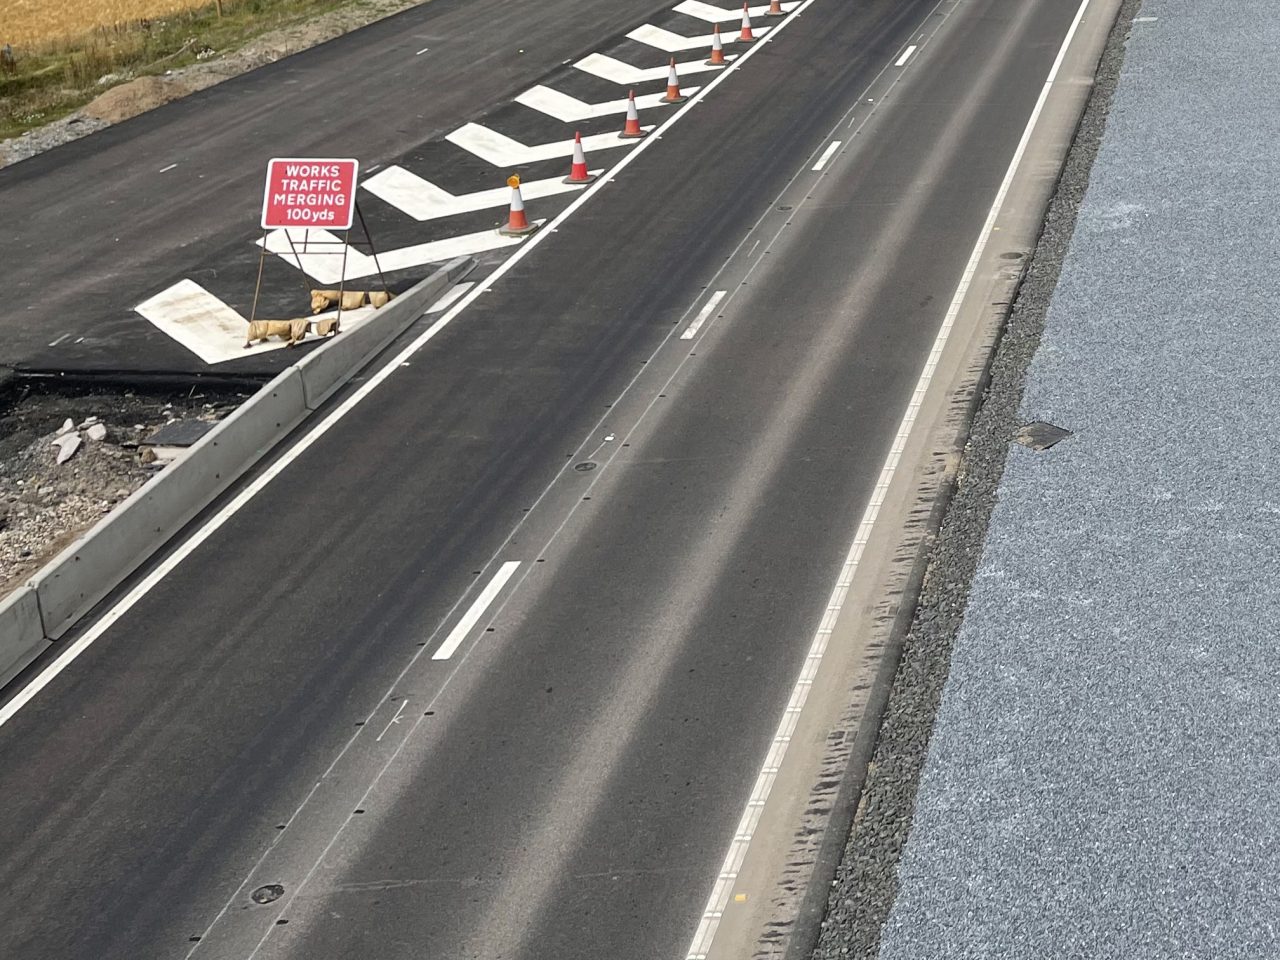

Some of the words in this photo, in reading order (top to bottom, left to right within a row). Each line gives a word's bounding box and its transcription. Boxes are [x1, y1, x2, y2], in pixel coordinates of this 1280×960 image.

[286, 165, 340, 177] WORKS
[281, 179, 342, 192] TRAFFIC
[273, 193, 345, 206] MERGING
[286, 208, 311, 220] 100
[312, 208, 335, 222] yds
